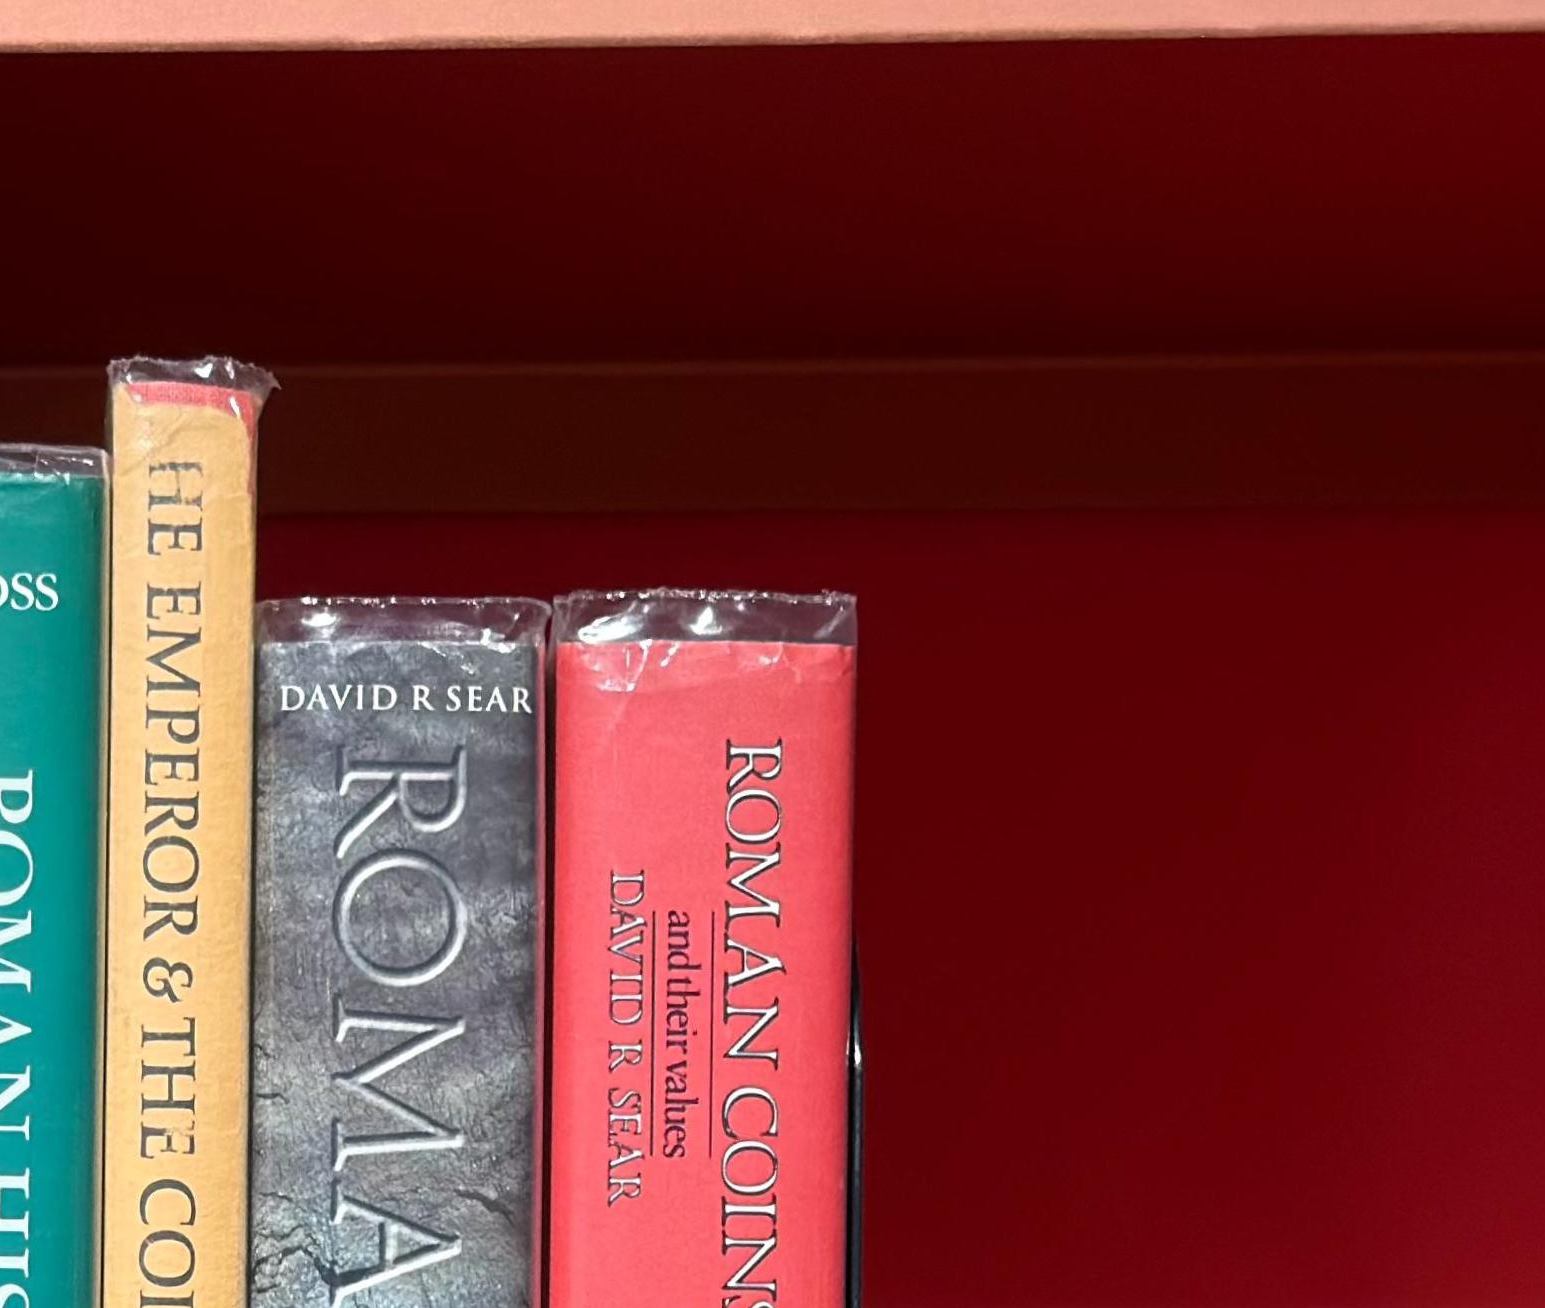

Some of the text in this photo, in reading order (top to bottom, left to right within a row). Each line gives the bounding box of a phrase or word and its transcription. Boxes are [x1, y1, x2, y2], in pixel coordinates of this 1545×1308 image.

[141, 581, 203, 941] EMPEROR
[280, 685, 533, 715] DAVID R SEAR
[142, 956, 194, 1004] &
[722, 738, 786, 1070] ROMAN
[140, 1017, 197, 1160] THE
[607, 868, 645, 1208] DAVID R SEAR
[663, 910, 702, 1159] and their values
